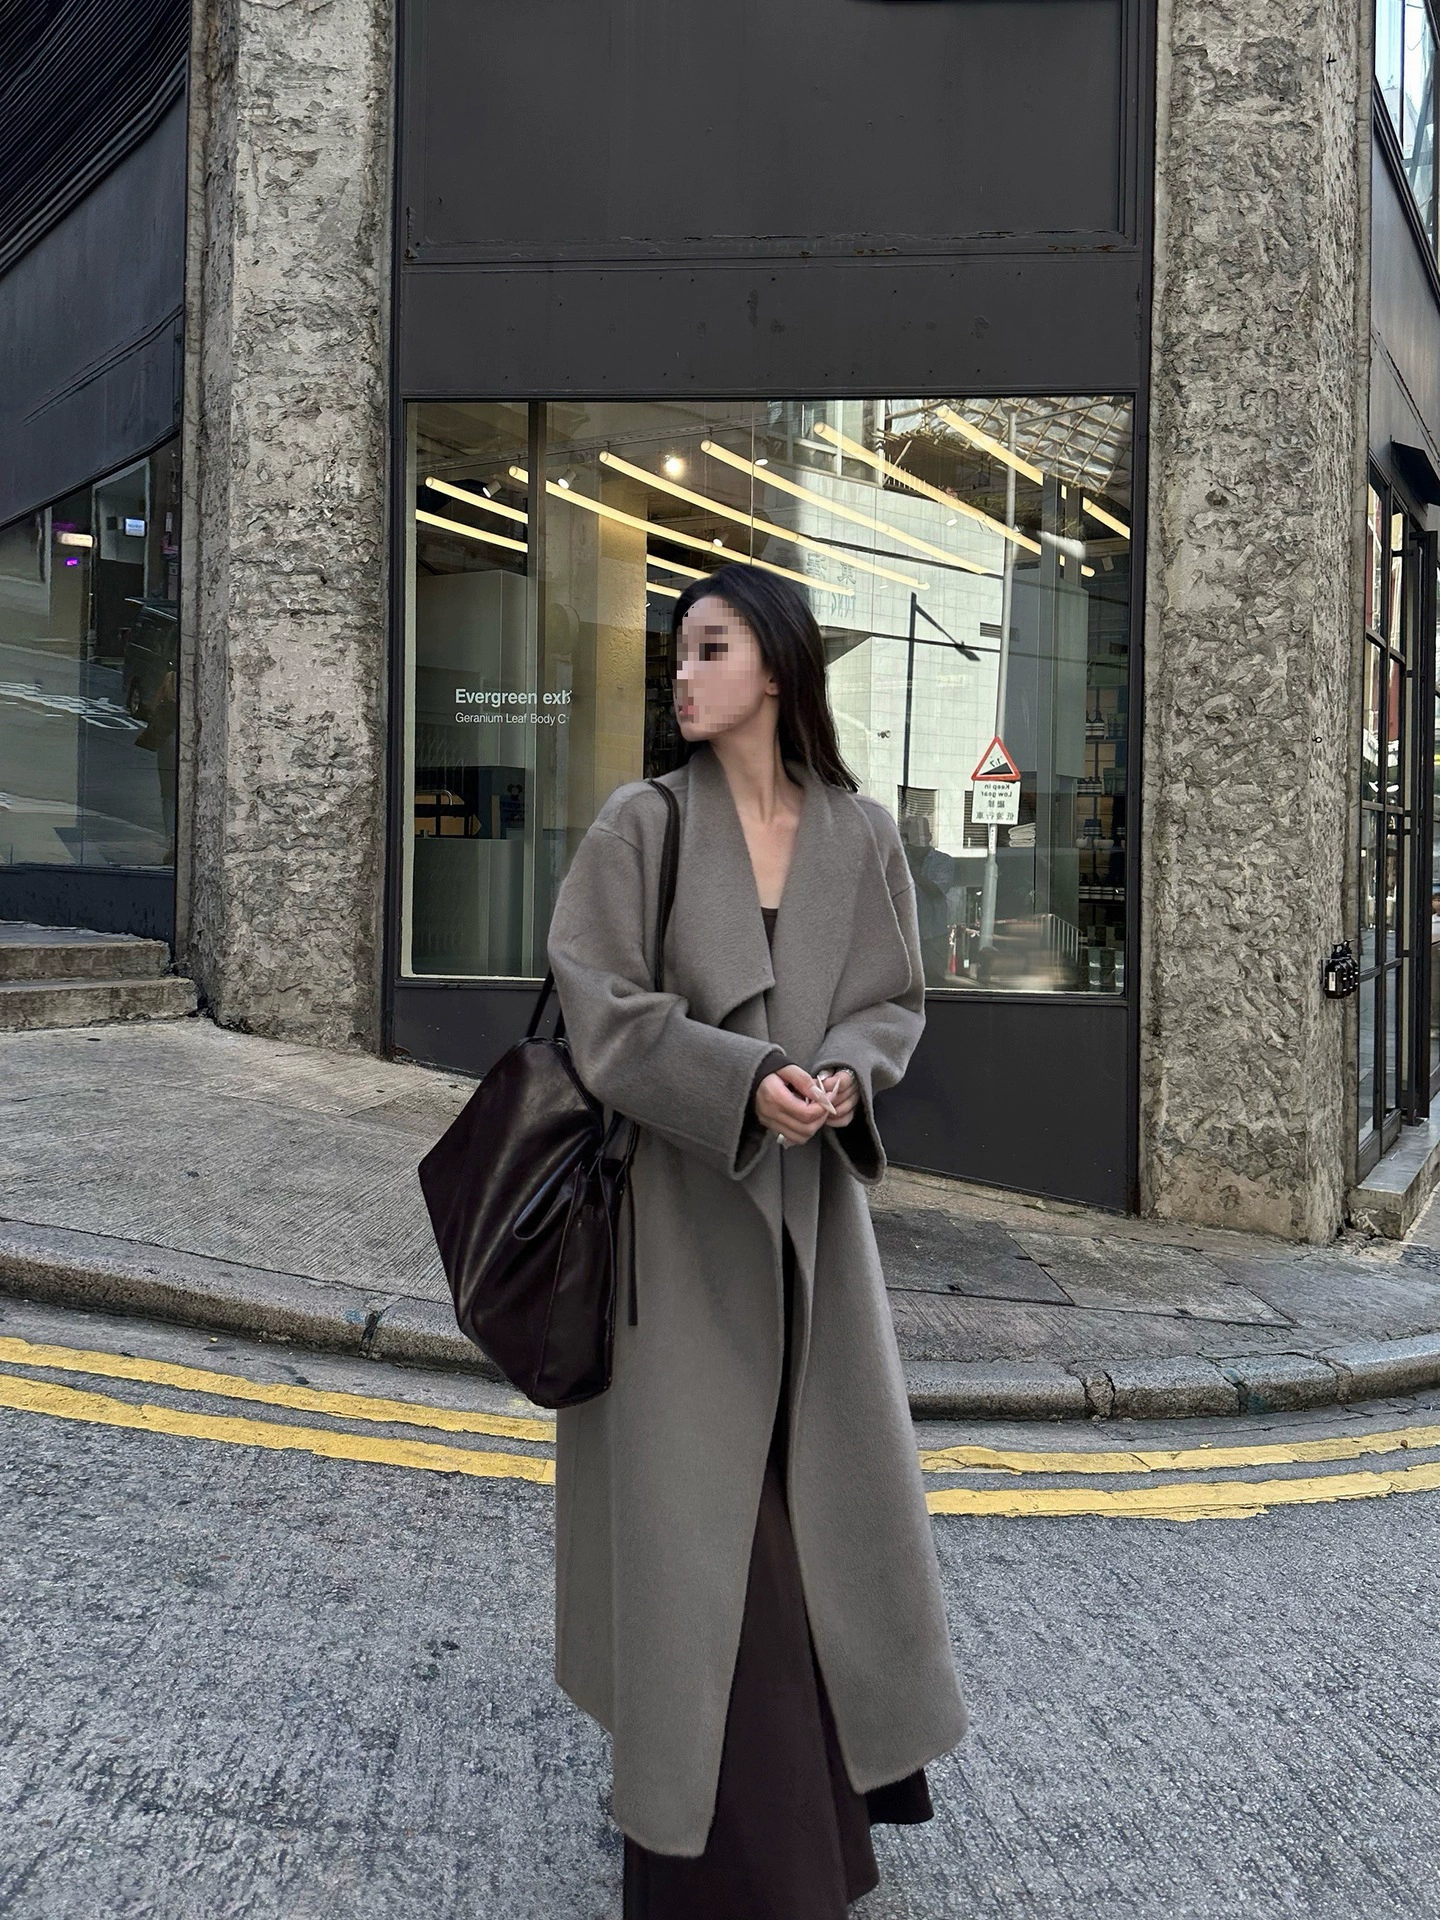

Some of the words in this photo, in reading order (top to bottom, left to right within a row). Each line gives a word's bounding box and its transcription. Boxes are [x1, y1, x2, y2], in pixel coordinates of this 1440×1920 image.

[455, 688, 538, 708] Evergreen
[455, 712, 503, 723] Geranium
[505, 713, 527, 723] Leaf
[530, 713, 556, 726] Body
